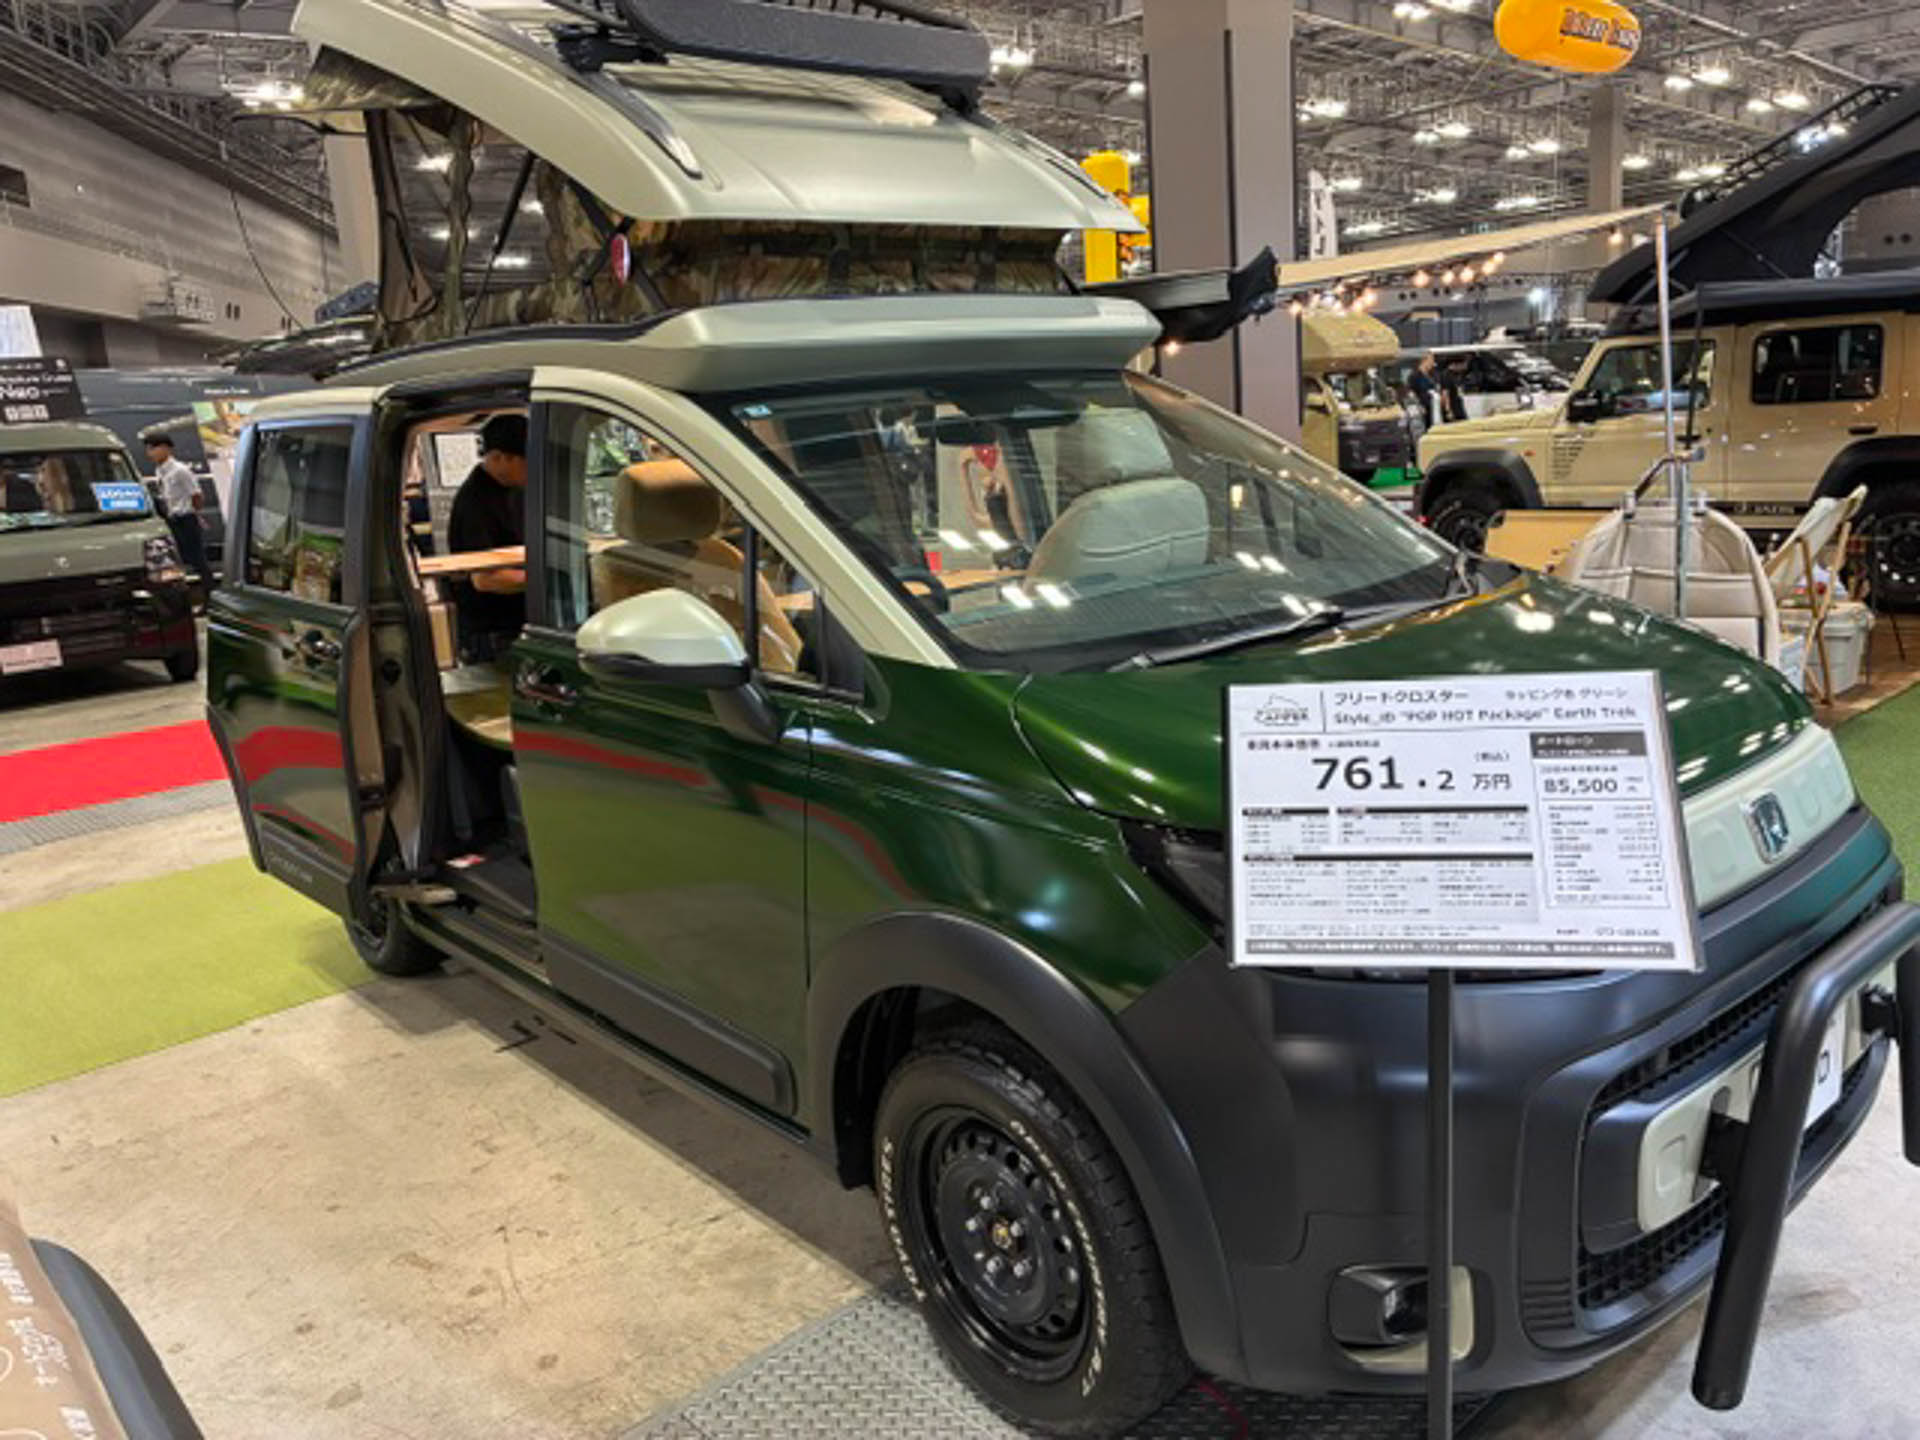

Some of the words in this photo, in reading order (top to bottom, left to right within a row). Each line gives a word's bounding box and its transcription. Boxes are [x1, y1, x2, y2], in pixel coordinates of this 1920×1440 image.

[1441, 710, 1474, 722] HOT
[1553, 705, 1597, 719] Earth
[1601, 705, 1637, 719] Trek
[1472, 772, 1513, 791] 万円
[1543, 777, 1618, 795] 85,500
